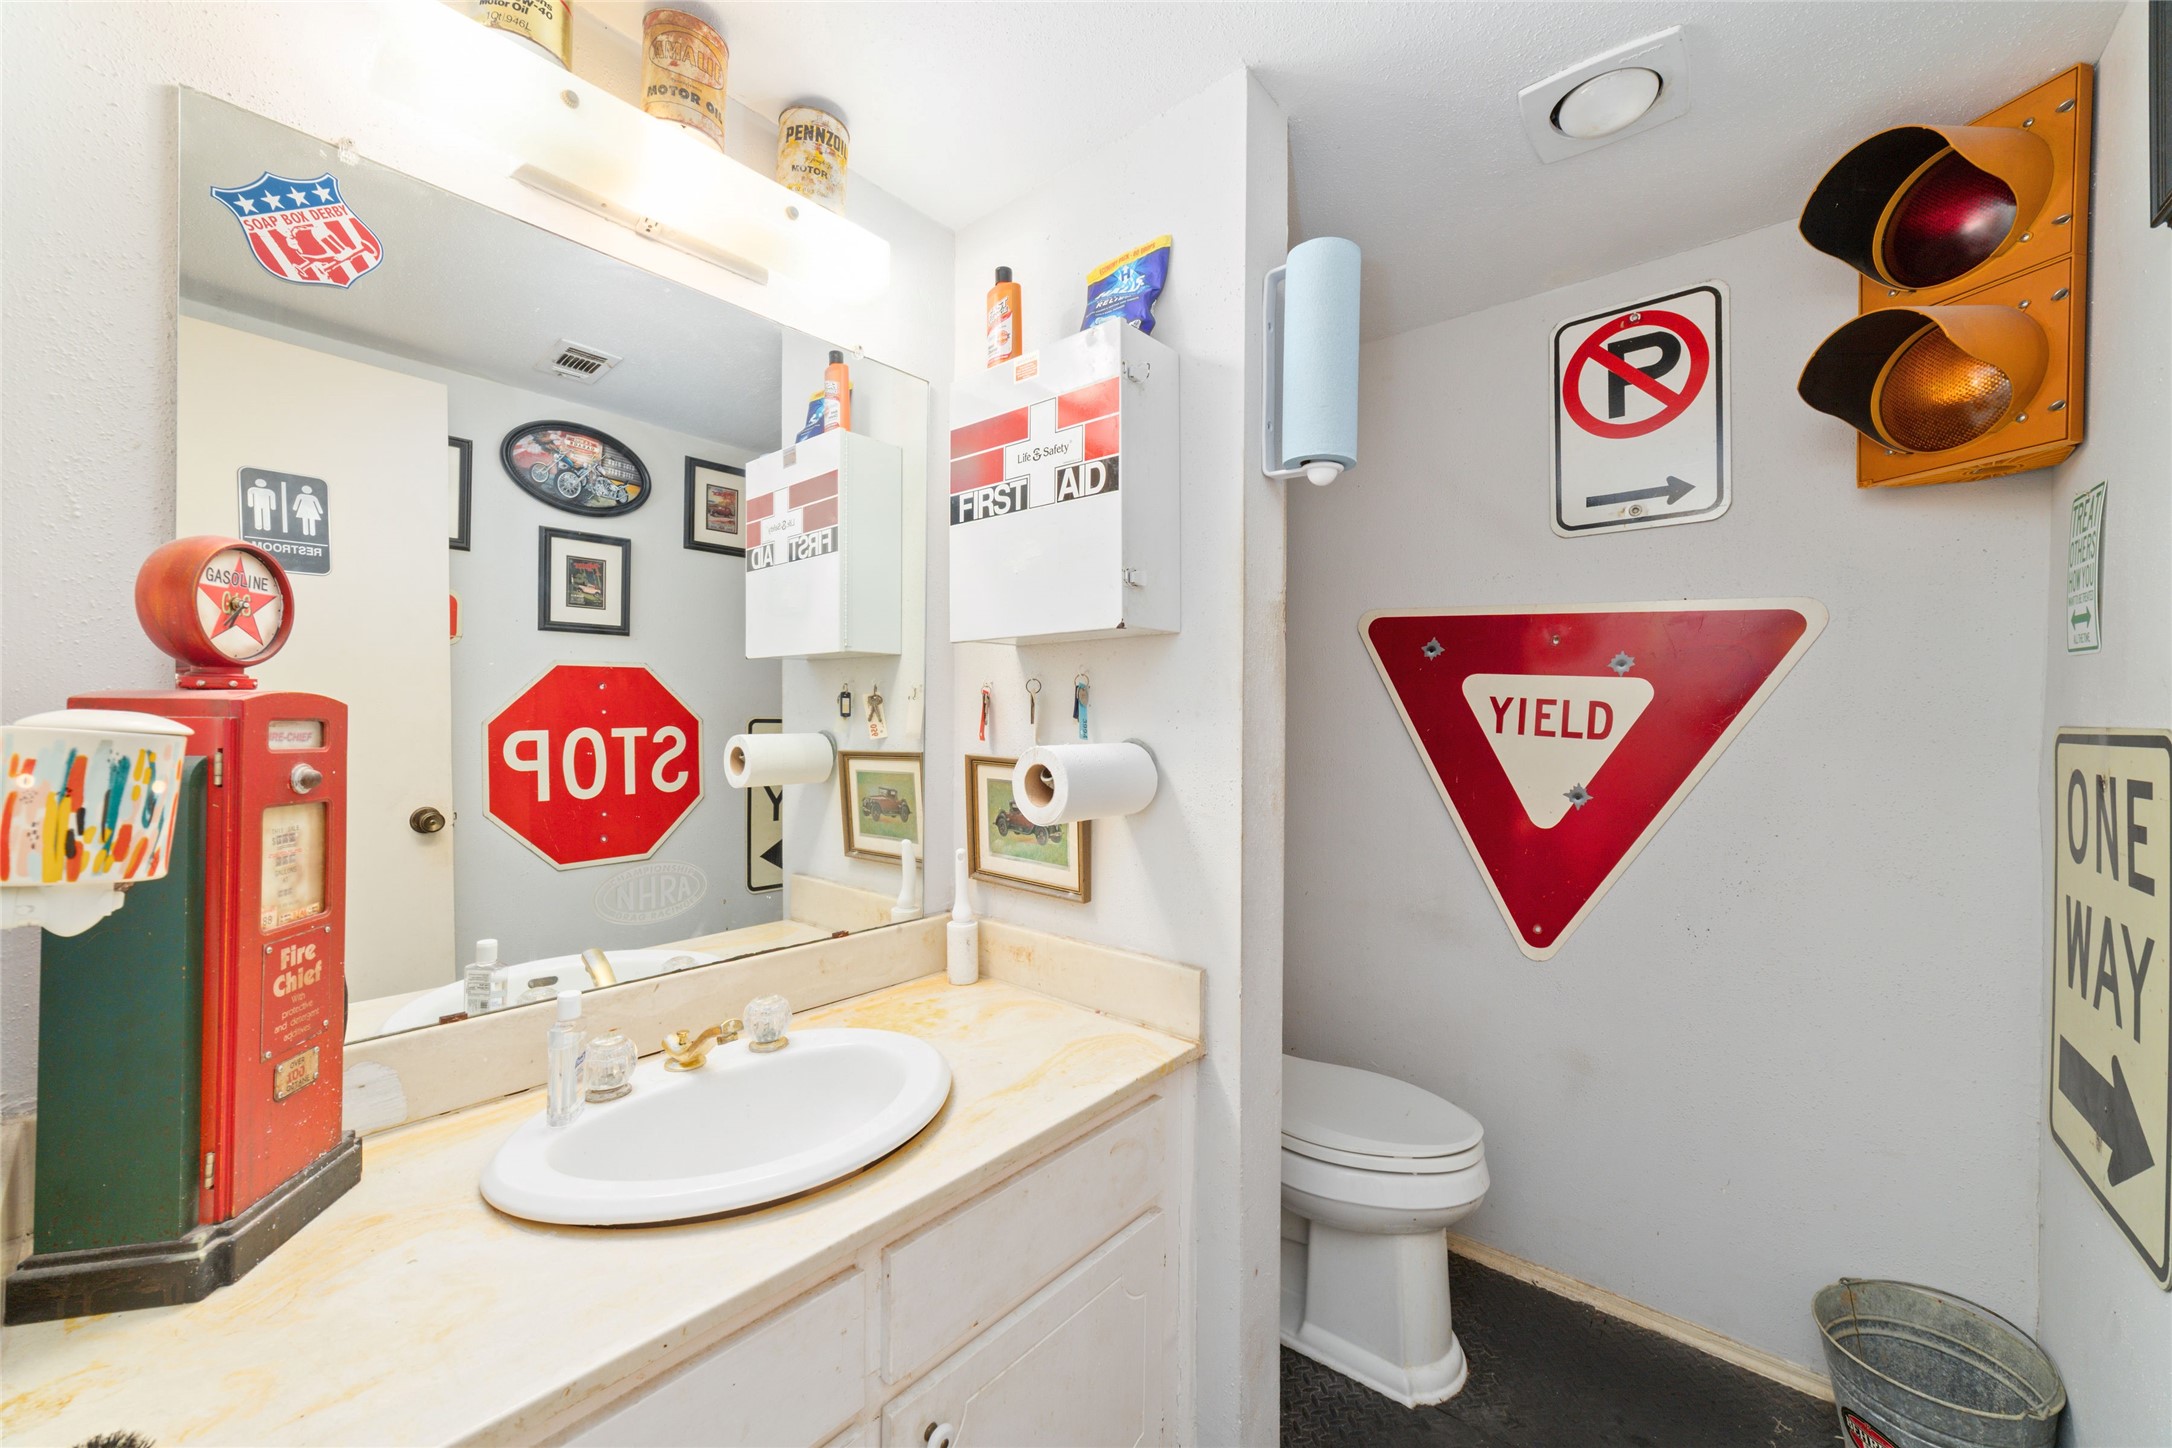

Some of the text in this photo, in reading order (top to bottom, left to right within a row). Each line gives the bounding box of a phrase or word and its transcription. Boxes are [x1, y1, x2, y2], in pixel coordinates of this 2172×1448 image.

[512, 2, 529, 15] Oil
[647, 84, 701, 105] MOTOR
[706, 101, 723, 125] OIL
[785, 124, 848, 161] PENNZOIL
[791, 164, 828, 179] MOTOR
[243, 204, 349, 231] SOAP BOX DERBY
[1607, 331, 1682, 419] P
[1017, 453, 1032, 464] Life
[1043, 443, 1070, 457] Safety
[958, 460, 1107, 523] FIRST AID
[2072, 490, 2102, 539] TREAT
[2069, 531, 2097, 568] OTHERS
[205, 567, 269, 592] GASOLINE
[2081, 562, 2095, 588] YOU
[1489, 696, 1614, 740] YIELD
[269, 731, 313, 742] IRE-CHIEF
[2067, 768, 2156, 897] ONE
[616, 874, 692, 911] NHRA
[280, 943, 317, 971] Fire
[2066, 894, 2156, 1045] WAY
[273, 960, 323, 998] Chief
[281, 1000, 314, 1021] protective
[291, 992, 306, 1004] With
[274, 1007, 320, 1034] and detergent
[289, 1056, 305, 1069] OVER
[286, 1074, 311, 1093] OCTANE
